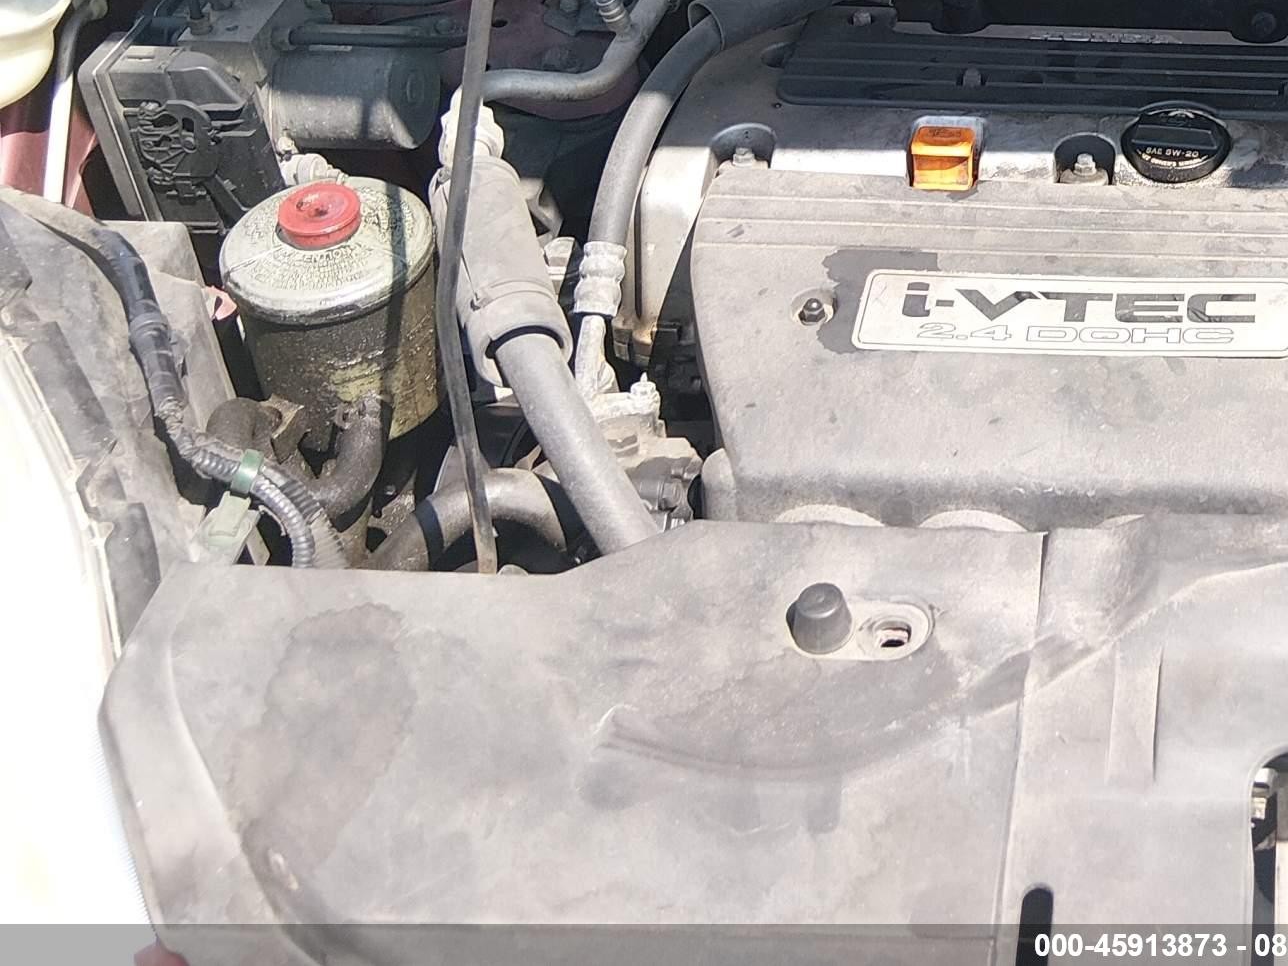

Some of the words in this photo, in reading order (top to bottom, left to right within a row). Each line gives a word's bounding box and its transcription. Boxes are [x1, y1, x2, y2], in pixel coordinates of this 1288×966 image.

[1146, 147, 1162, 155] SAE
[901, 281, 1256, 323] i-VTEC
[918, 323, 1012, 342] 2.4
[1026, 326, 1234, 345] DOHC
